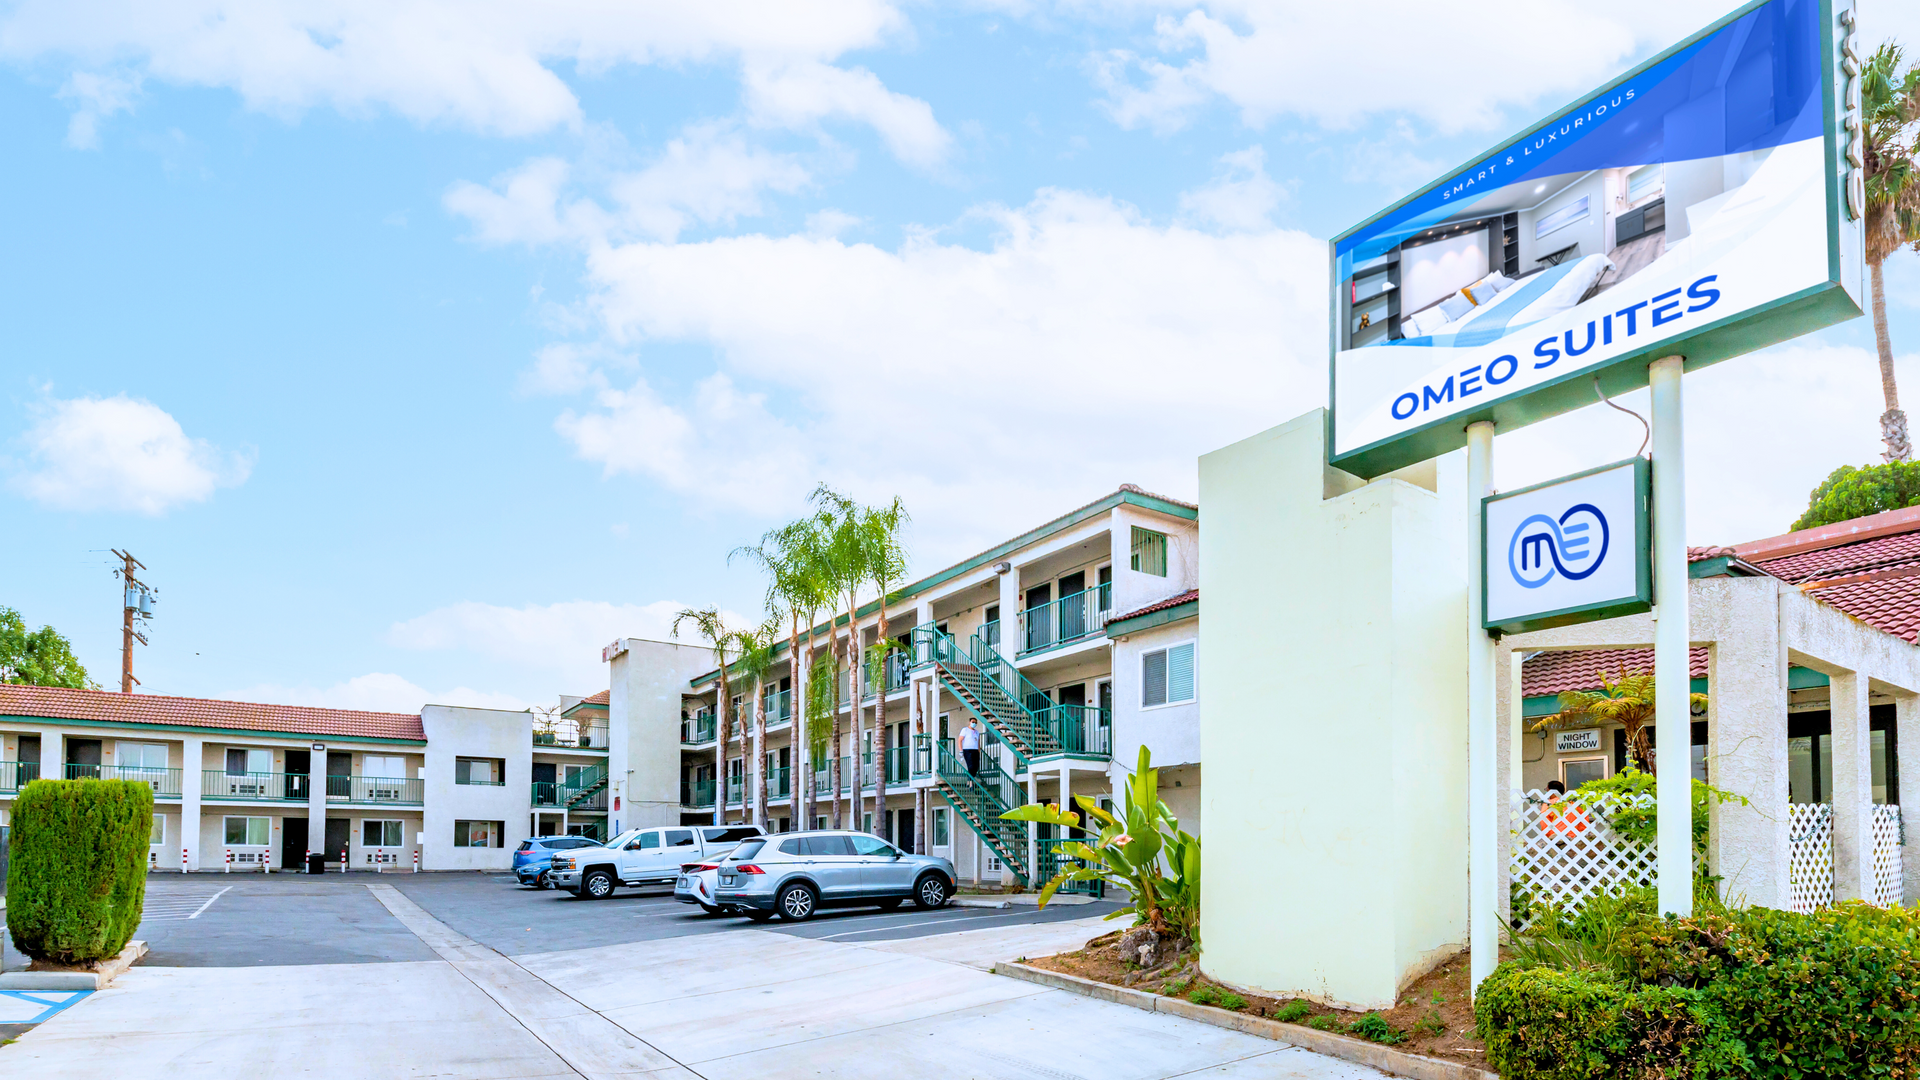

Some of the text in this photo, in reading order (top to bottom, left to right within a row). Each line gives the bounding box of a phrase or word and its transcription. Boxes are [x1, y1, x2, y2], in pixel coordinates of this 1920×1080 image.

[1443, 89, 1635, 200] SMART & LUXURIOUS
[1391, 274, 1721, 420] OMEO SUITES
[1557, 740, 1598, 750] WINDOW
[1563, 731, 1592, 742] NIGHT
